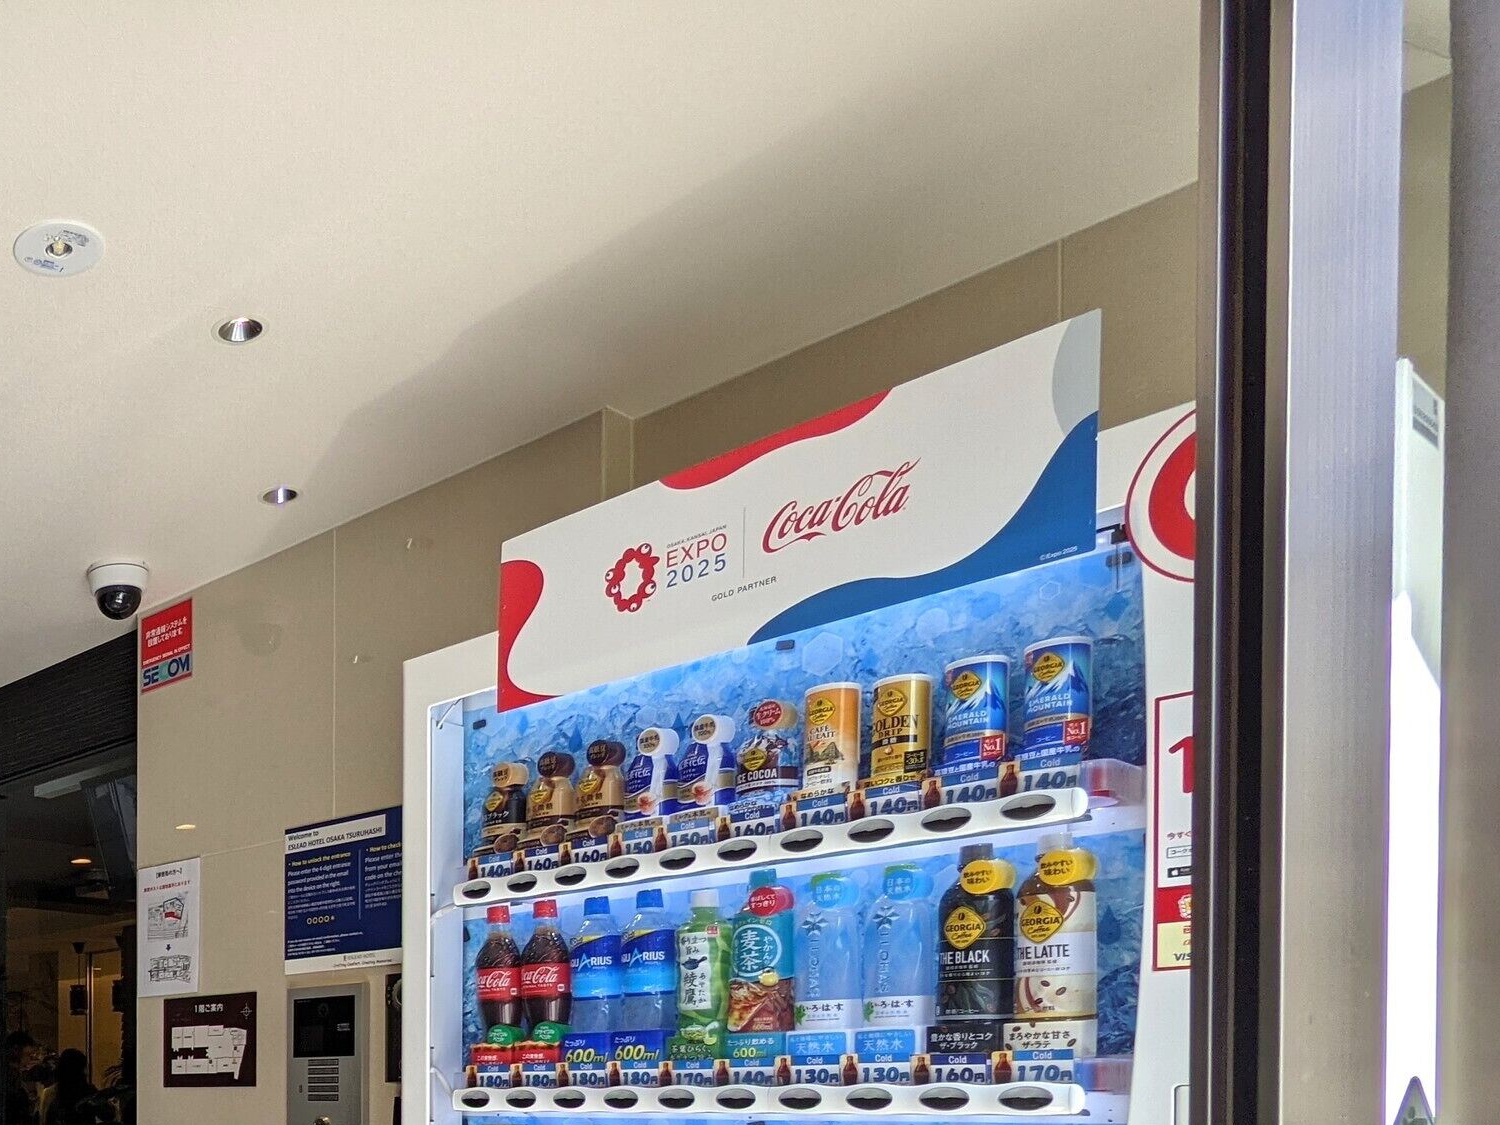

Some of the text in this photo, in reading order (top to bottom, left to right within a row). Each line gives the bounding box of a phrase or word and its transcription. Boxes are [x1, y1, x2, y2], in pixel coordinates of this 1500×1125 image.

[762, 457, 921, 553] Coca-Cola
[666, 533, 727, 568] EXPO
[666, 553, 727, 588] 2025
[711, 576, 777, 602] GOLD PARTNER
[143, 653, 190, 687] SECOM
[879, 728, 904, 740] DRIP
[1040, 757, 1061, 768] Cold
[747, 767, 778, 782] COCOA
[960, 772, 980, 783] Cold
[1024, 770, 1078, 791] 140円
[883, 785, 901, 795] Cold
[811, 798, 828, 807] Cold
[744, 810, 760, 820] Cold
[680, 821, 695, 830] Cold
[287, 832, 312, 841] Welcome
[287, 827, 382, 851] ESLEAD HOTEL OSAKA TSURUHASHI
[635, 830, 648, 839] Cold
[582, 839, 596, 847] Cold
[535, 847, 548, 856] Cold
[1042, 866, 1071, 876] 味わい
[966, 875, 991, 885] 味わい
[1021, 915, 1061, 927] GEORGIA
[945, 922, 982, 934] GEORGIA
[740, 930, 761, 971] 麦茶
[1018, 943, 1070, 961] THE LATTE
[570, 953, 612, 971] QUARIUS
[621, 948, 665, 968] QUARIUS
[940, 949, 990, 965] THE BLACK
[1173, 953, 1191, 961] VIS
[682, 972, 698, 1005] 綾鷹
[614, 1036, 636, 1044] たっぷり
[727, 1037, 775, 1047] たっぷり飲める
[930, 1031, 993, 1042] 豊かな香りとコク
[1008, 1030, 1072, 1042] まろやかな甘さ
[564, 1039, 586, 1047] たっぷり
[796, 1039, 834, 1053] 天然水
[864, 1037, 904, 1052] 天然水
[1022, 1040, 1052, 1050] ザ・ラテ
[565, 1048, 609, 1063] 600ml
[615, 1045, 660, 1061] 600ml
[874, 1053, 893, 1063] Cold
[1032, 1049, 1053, 1060] Cold
[579, 1062, 593, 1070] Cold
[633, 1061, 647, 1069] Cold
[686, 1060, 700, 1069] Cold
[744, 1058, 760, 1067] Cold
[806, 1056, 824, 1065] Cold
[948, 1055, 967, 1065] Cold
[533, 1063, 546, 1072] Cold
[1016, 1064, 1073, 1082] 170円
[572, 1073, 606, 1087] 180円
[623, 1072, 658, 1085] 180円
[795, 1068, 840, 1084] 130円
[863, 1066, 910, 1083] 130円
[934, 1066, 986, 1084] 160円
